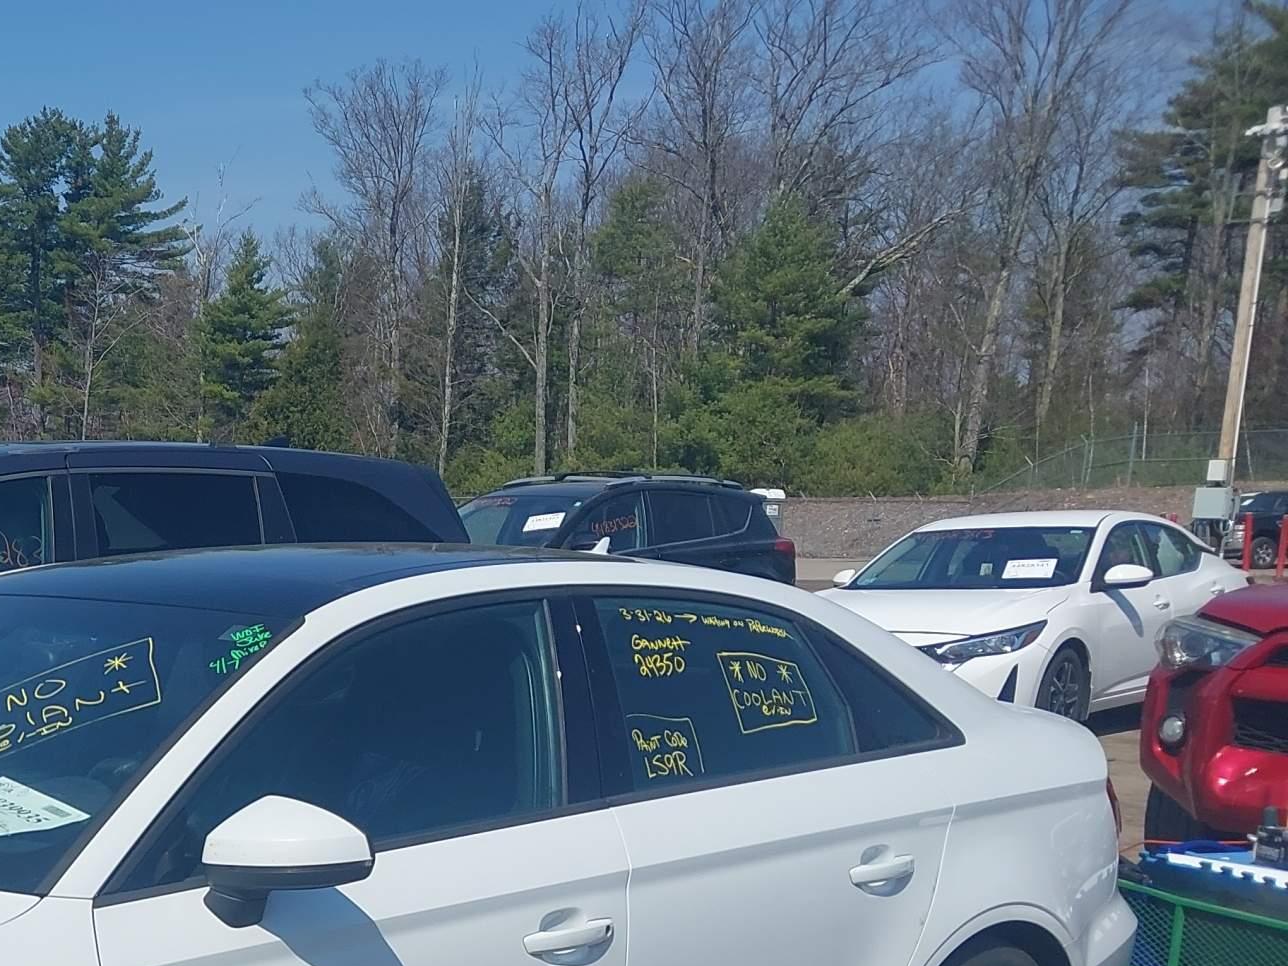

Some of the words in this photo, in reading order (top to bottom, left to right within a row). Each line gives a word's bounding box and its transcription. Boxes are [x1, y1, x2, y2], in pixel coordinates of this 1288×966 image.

[634, 652, 686, 678] 24350
[746, 660, 767, 681] NO
[6, 680, 66, 712] NO
[732, 688, 808, 710] COOLANT
